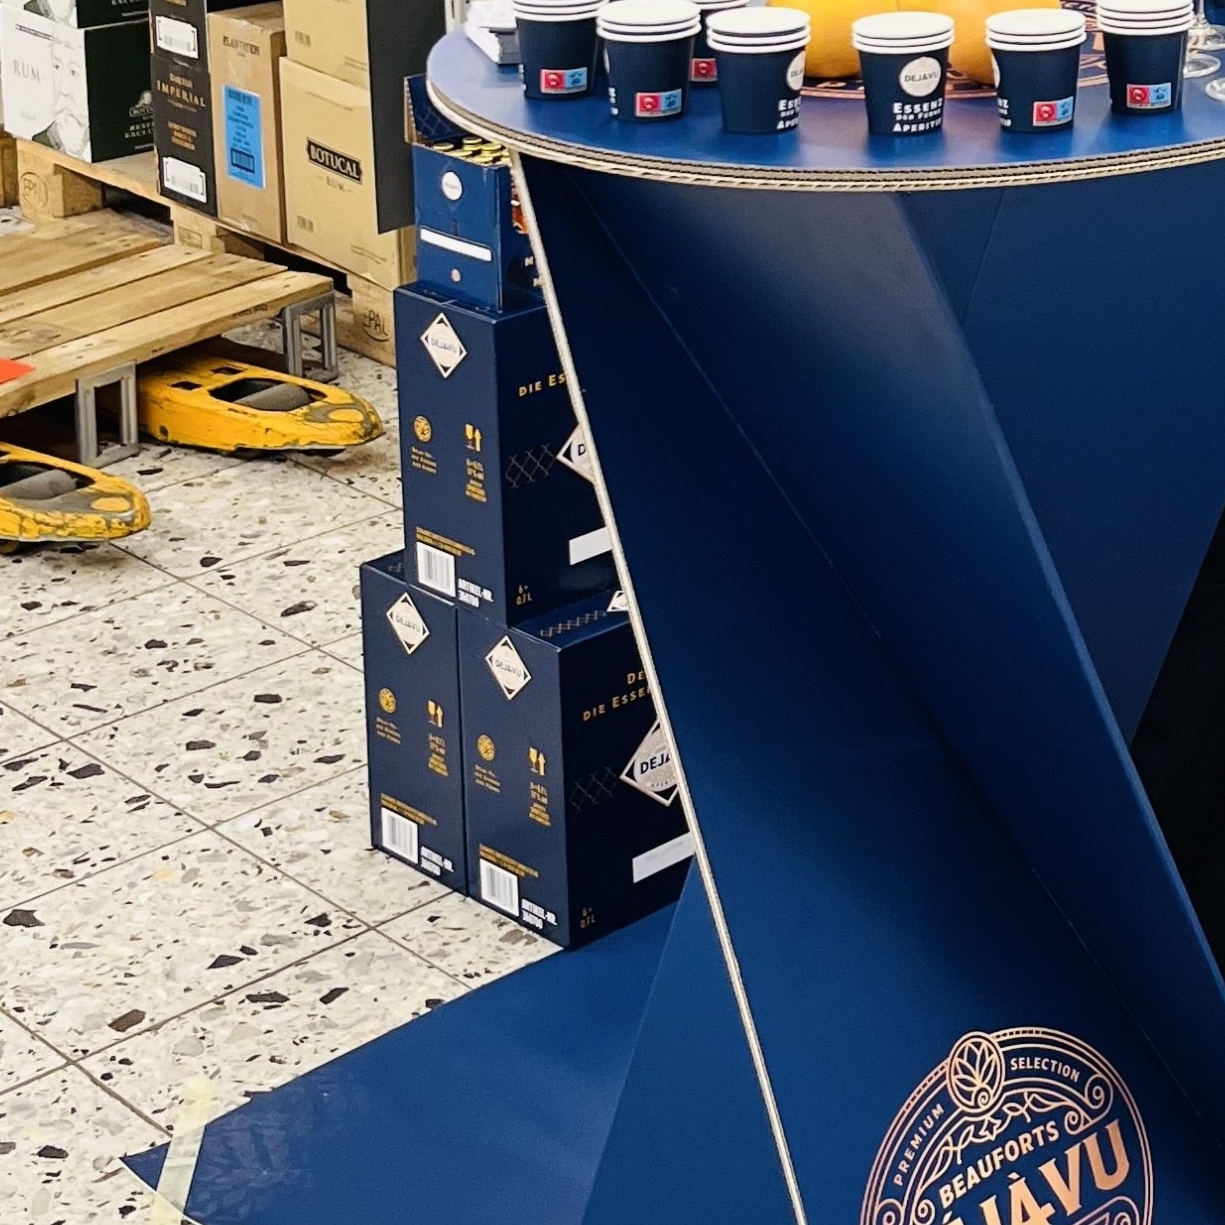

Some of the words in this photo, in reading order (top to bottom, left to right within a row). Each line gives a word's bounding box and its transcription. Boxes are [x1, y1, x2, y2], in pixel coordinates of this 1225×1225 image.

[13, 60, 41, 82] RUM
[156, 79, 206, 108] IMPERIAL
[893, 97, 942, 115] ESSENZ
[892, 118, 942, 133] APERITIF
[310, 144, 360, 177] BOTUCAL
[518, 381, 542, 397] DIE
[583, 704, 606, 722] DIE
[612, 686, 650, 709] ESSE
[1010, 1056, 1081, 1083] SELECTION
[893, 1103, 945, 1187] PREMIUM
[938, 1121, 1061, 1209] BEAUFORTS
